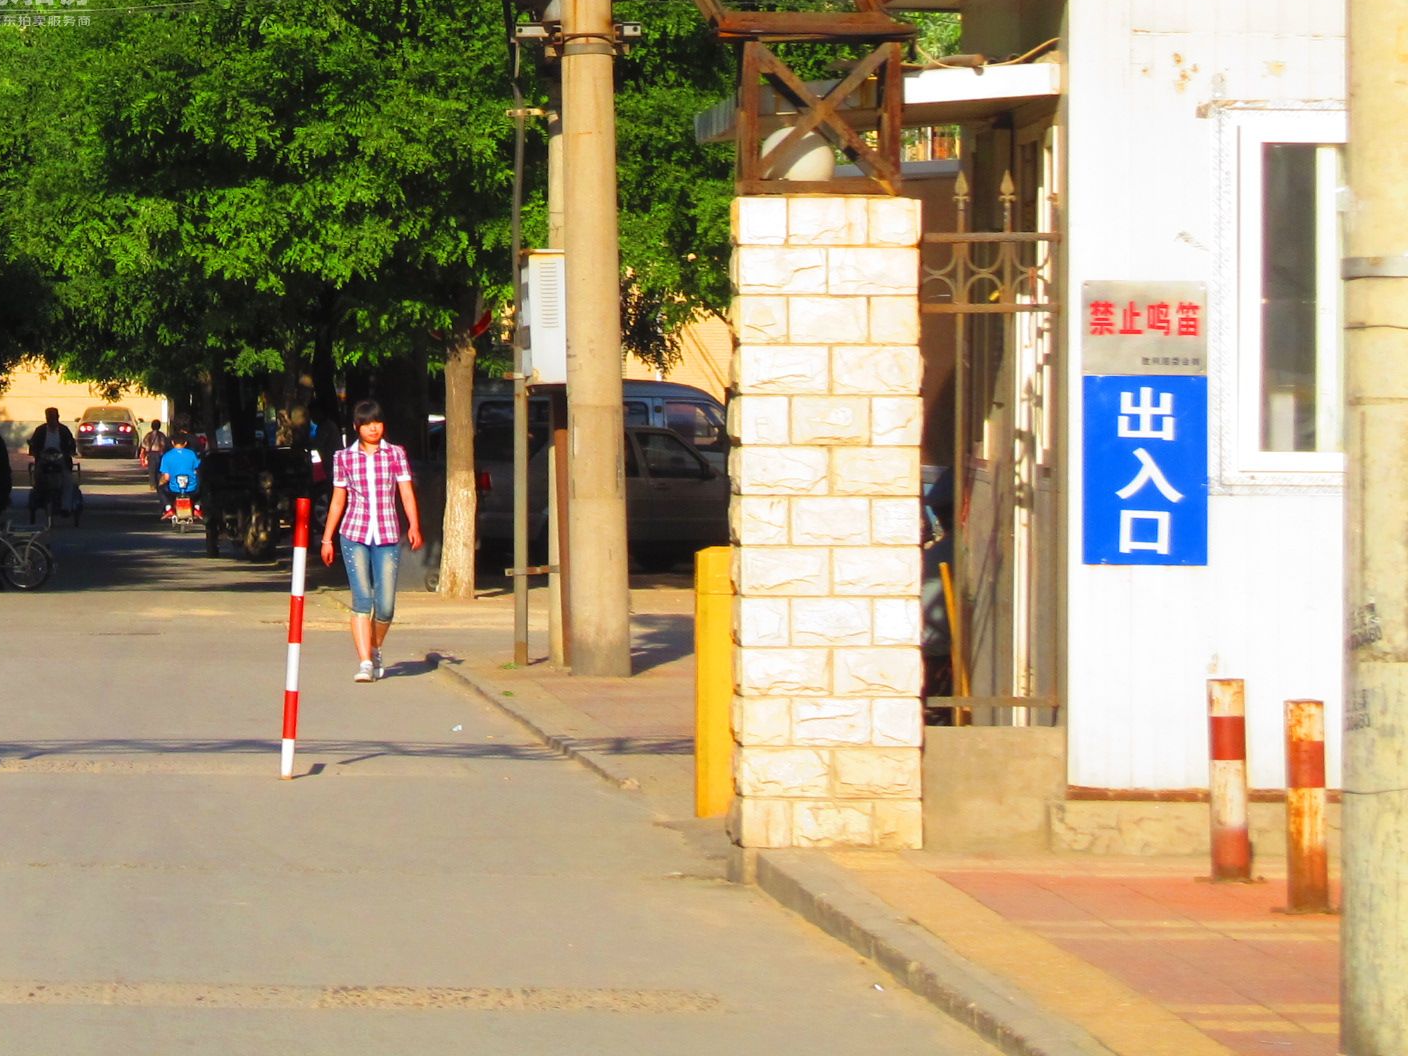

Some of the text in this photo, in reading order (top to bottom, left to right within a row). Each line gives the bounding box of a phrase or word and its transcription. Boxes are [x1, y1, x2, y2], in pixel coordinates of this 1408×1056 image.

[1089, 300, 1201, 336] 禁止鸣笛
[1115, 386, 1184, 555] 出入口
